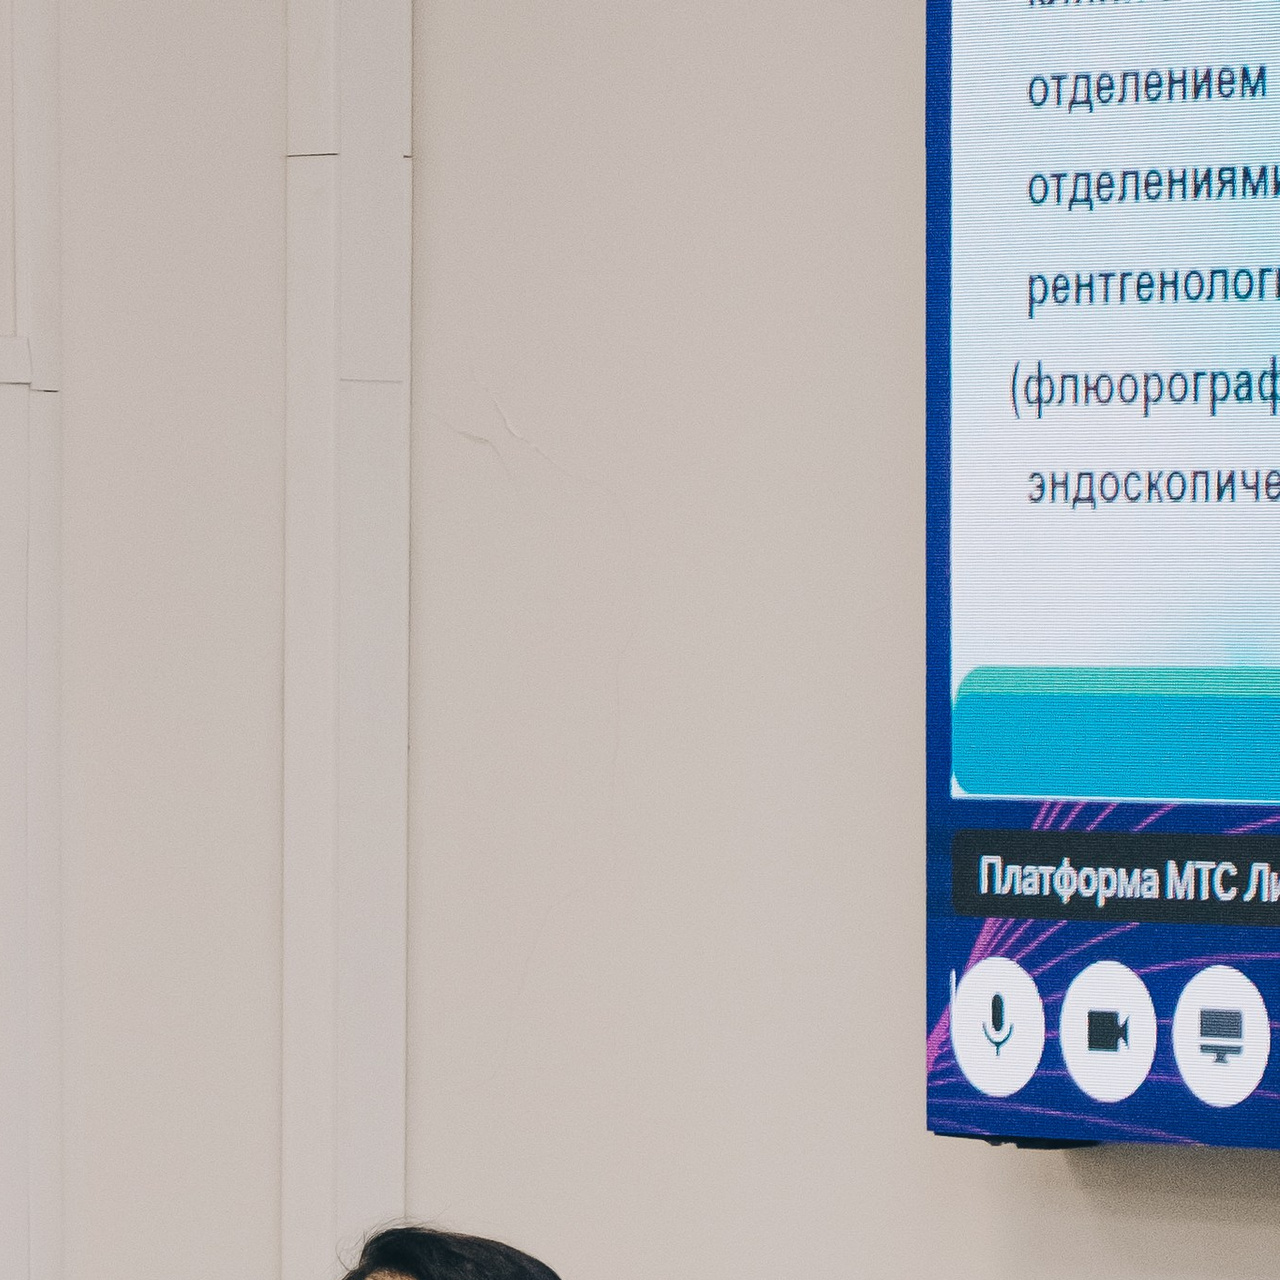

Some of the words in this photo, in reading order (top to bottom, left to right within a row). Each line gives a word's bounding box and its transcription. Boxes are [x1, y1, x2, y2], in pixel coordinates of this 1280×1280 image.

[1027, 65, 1267, 113] отделением
[1027, 267, 1280, 319] рентгенолог
[1011, 356, 1280, 419] (флюорограф
[1027, 470, 1280, 510] эндоскопиче
[979, 855, 1160, 908] Платформа
[1164, 860, 1238, 902] МТС
